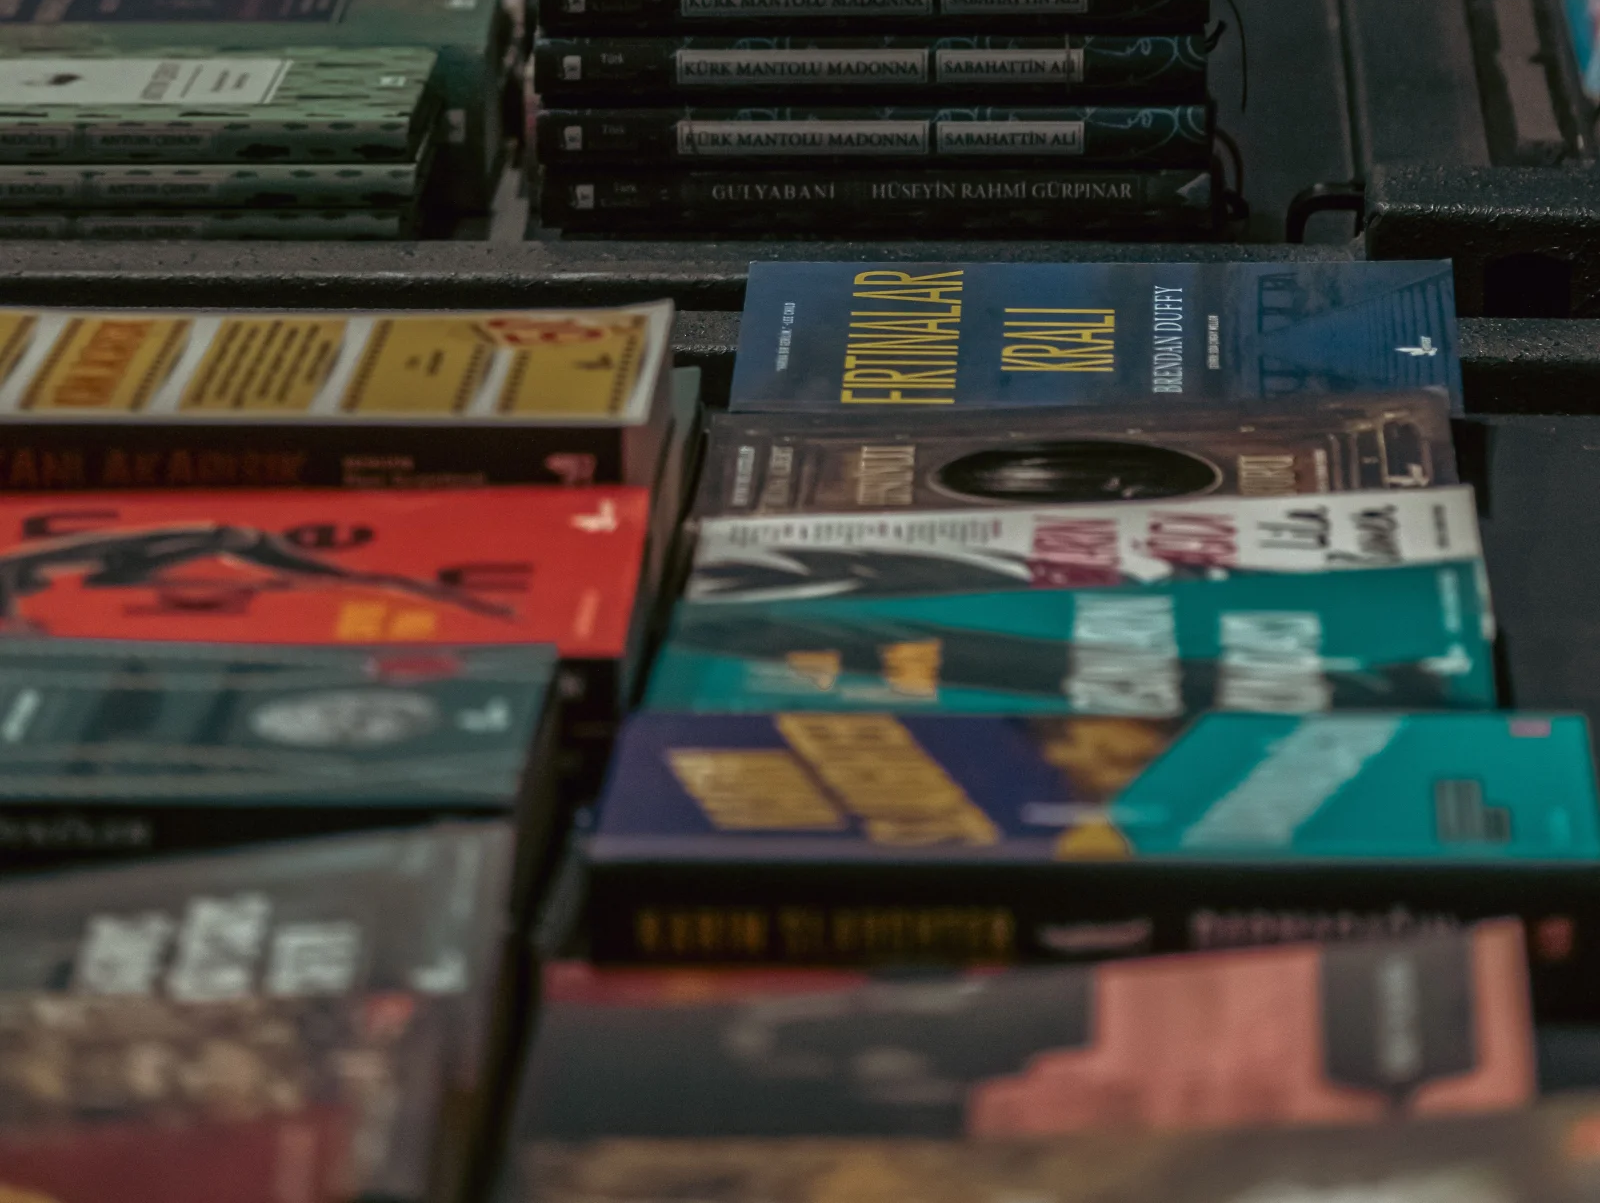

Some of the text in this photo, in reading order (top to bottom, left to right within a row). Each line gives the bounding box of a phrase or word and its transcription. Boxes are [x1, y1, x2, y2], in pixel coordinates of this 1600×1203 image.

[684, 58, 919, 76] KÜRK MANTOLU MADONNA
[943, 56, 1046, 74] SABAHATTİN
[737, 133, 823, 147] MANTOLU
[827, 133, 920, 147] MADONNA
[944, 129, 1076, 147] SABAHATTİN ALİ
[871, 180, 1133, 199] HÜSEYİN RAHMİ GÜRPINAR
[841, 269, 964, 405] FIRTINALAR
[1000, 308, 1116, 373] KRALI
[1152, 285, 1183, 394] BRENDAN DUFFY
